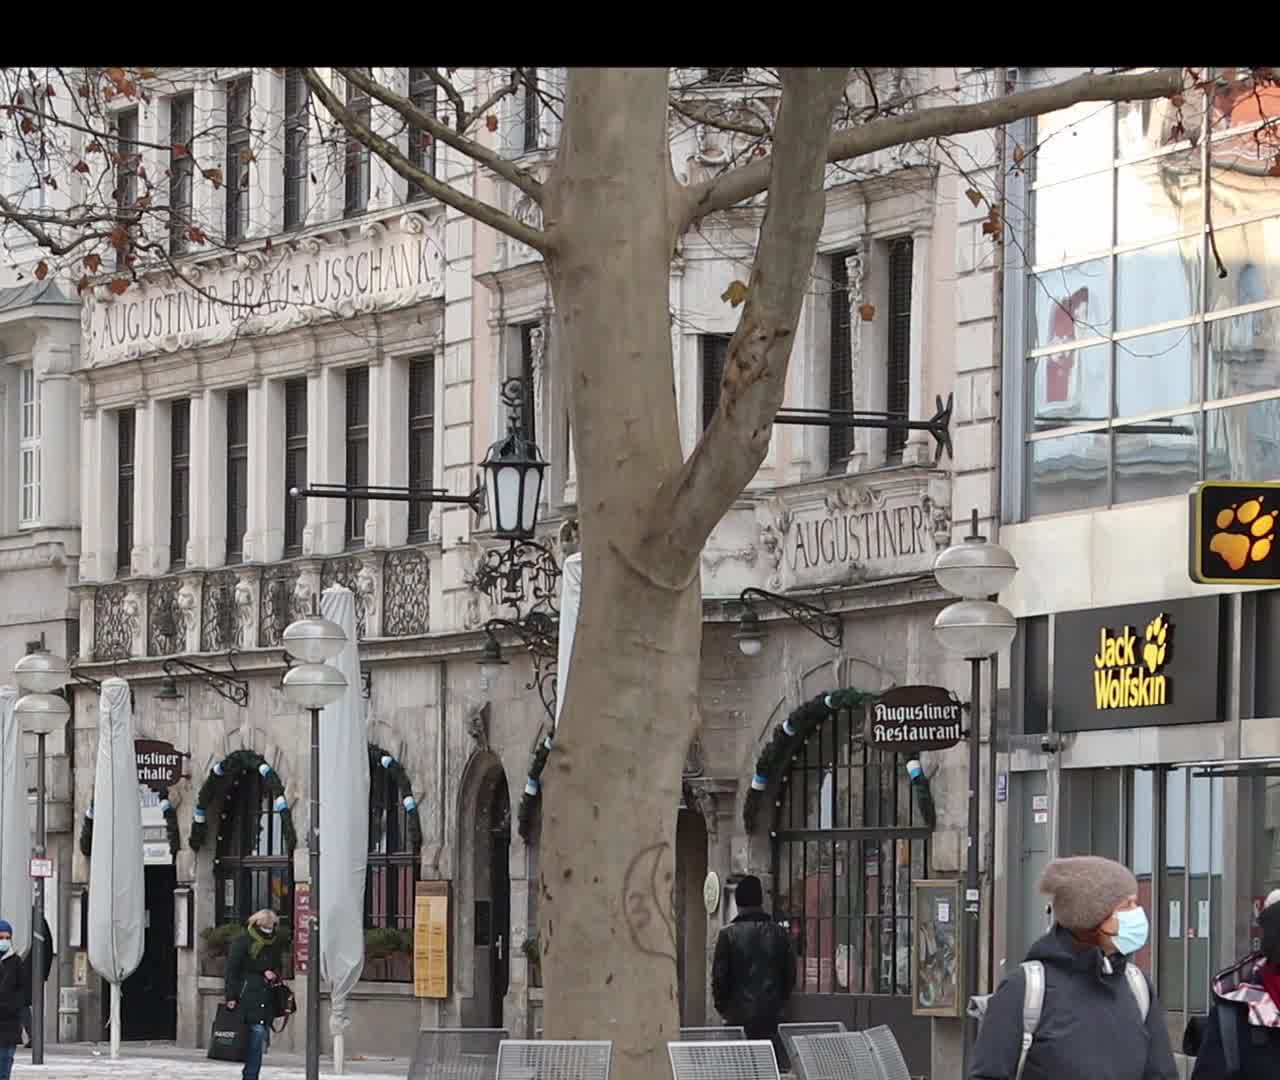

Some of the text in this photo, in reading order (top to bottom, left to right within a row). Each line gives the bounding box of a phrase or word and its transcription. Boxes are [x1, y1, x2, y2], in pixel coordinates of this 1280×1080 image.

[99, 283, 220, 349] AUGUSTINER
[303, 238, 432, 304] AUSSCHANK
[792, 505, 925, 571] AUGUSTINER
[1094, 625, 1136, 668] Jack
[1094, 666, 1166, 710] Wolfskin
[874, 703, 958, 724] Augustiner
[873, 723, 960, 742] Restaurant
[136, 751, 179, 766] ustiner
[138, 766, 173, 780] rhalle
